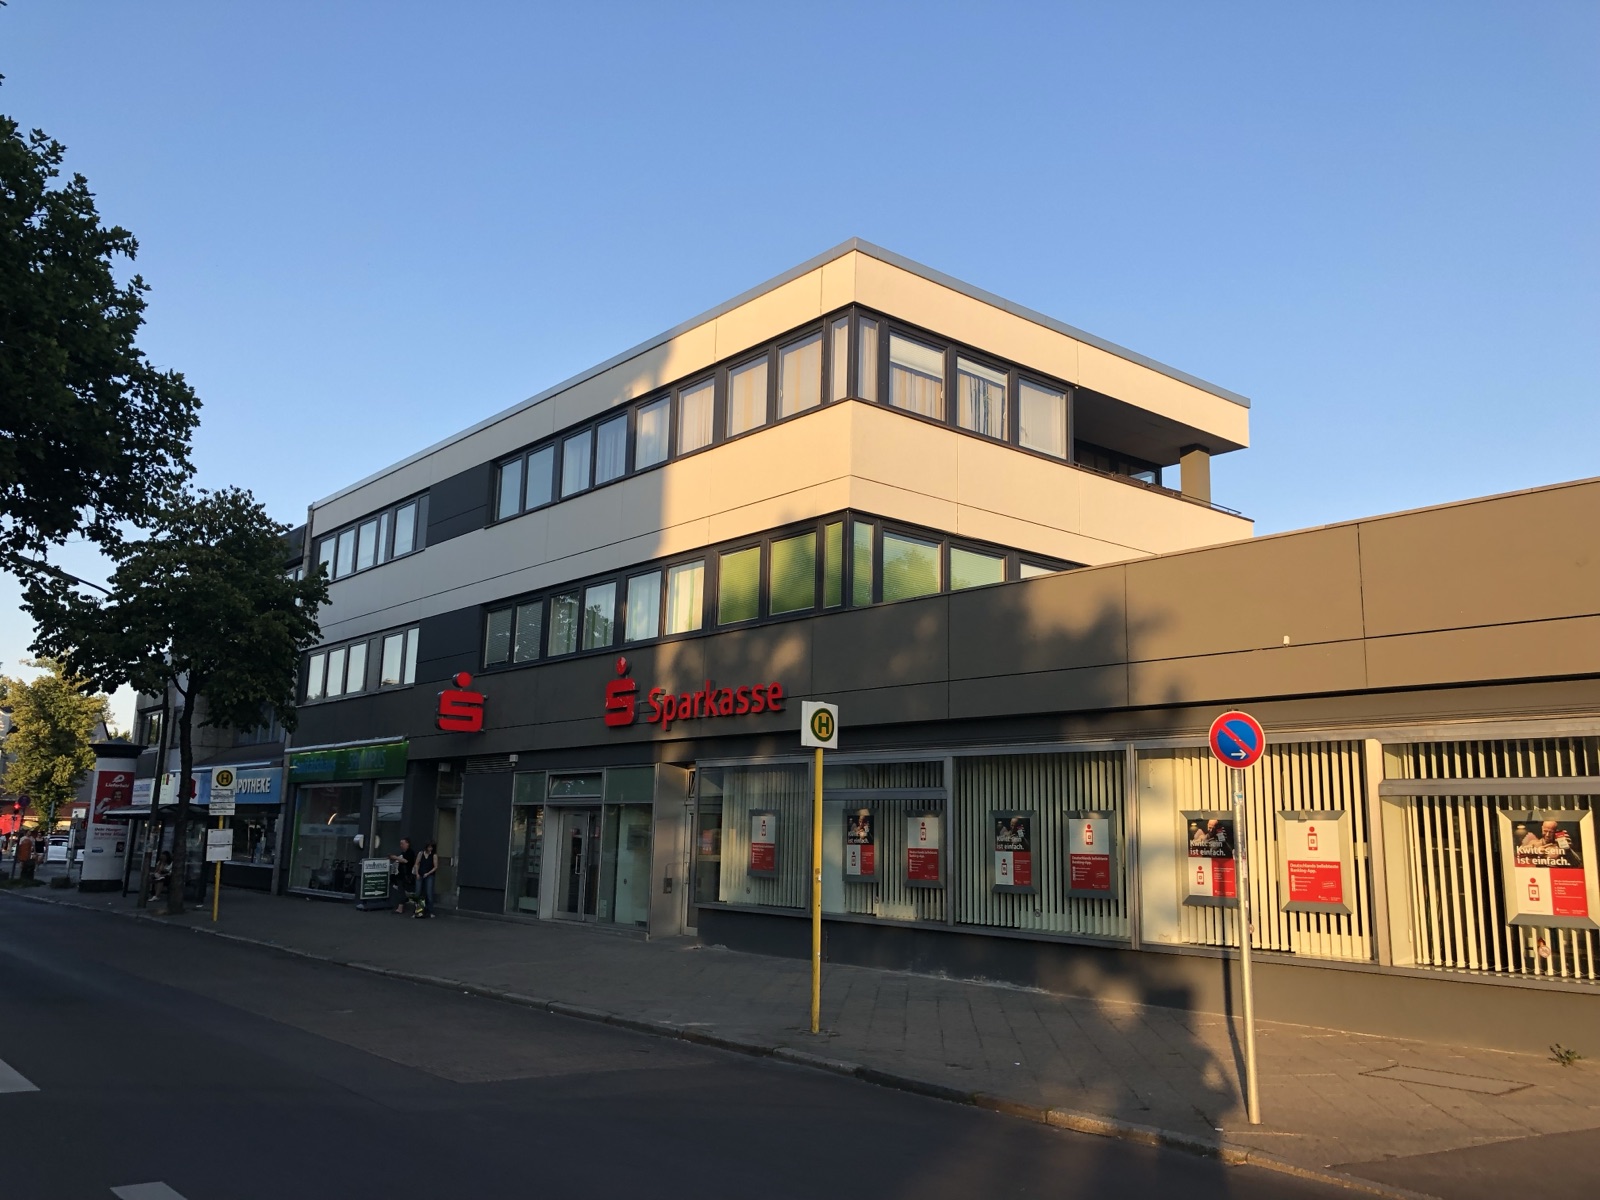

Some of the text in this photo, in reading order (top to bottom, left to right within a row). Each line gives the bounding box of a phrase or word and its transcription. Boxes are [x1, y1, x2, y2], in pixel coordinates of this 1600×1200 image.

[647, 679, 785, 731] Sparkasse
[1200, 848, 1226, 856] einfach.
[1544, 846, 1566, 855] sein
[1517, 856, 1571, 866] ist einfach.
